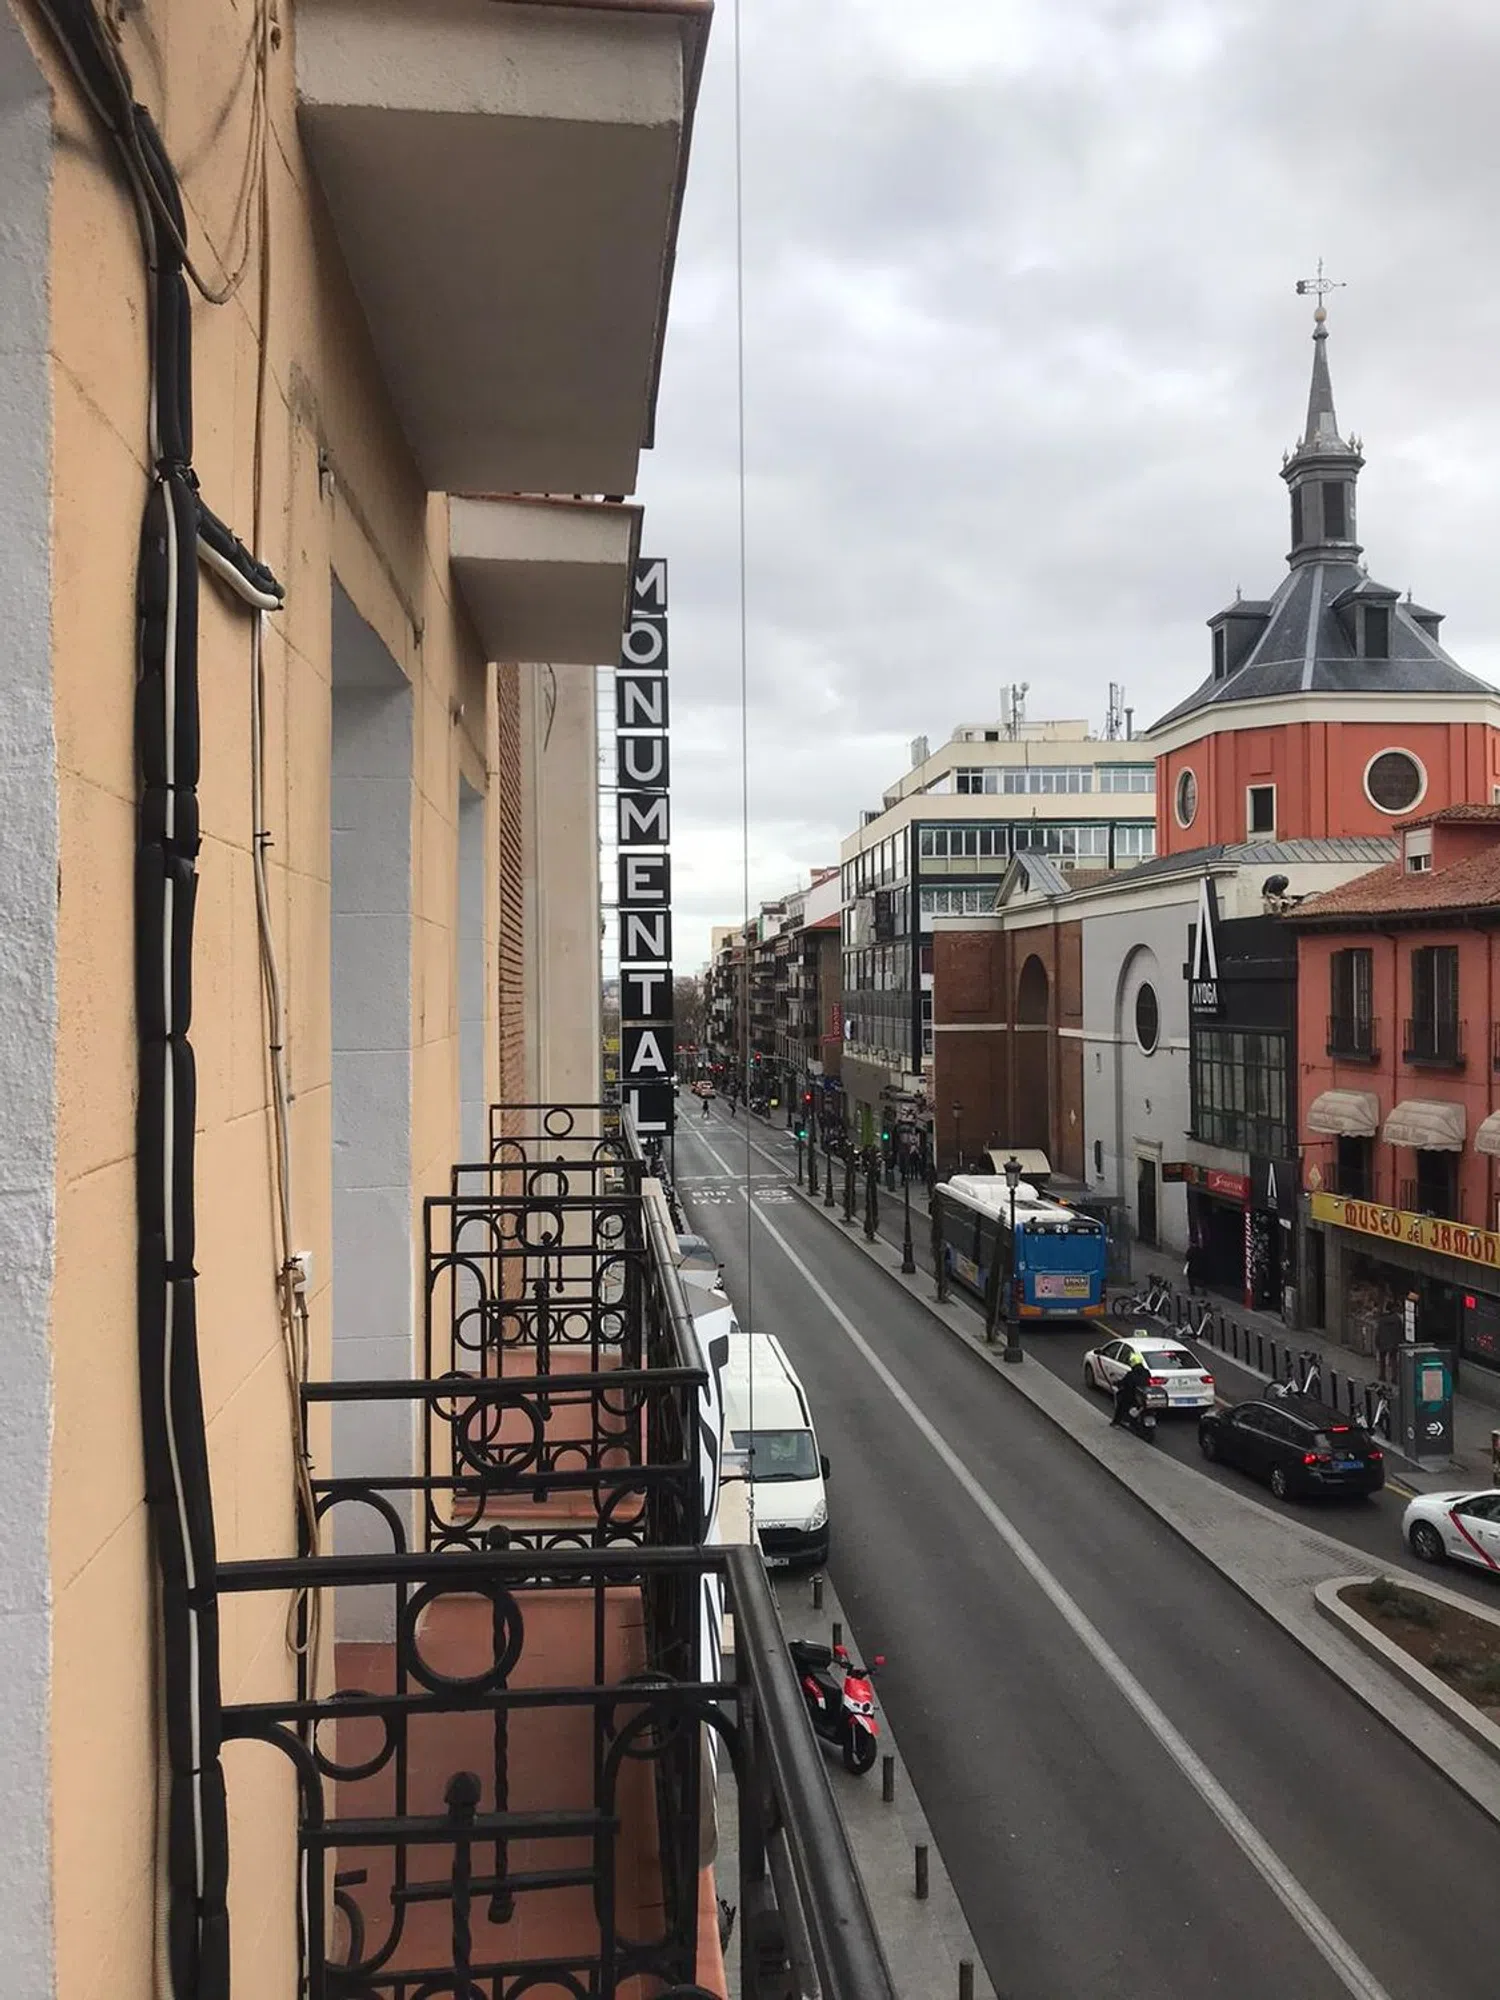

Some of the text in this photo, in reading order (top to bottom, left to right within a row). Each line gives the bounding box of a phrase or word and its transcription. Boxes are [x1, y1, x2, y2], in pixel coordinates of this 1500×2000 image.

[621, 561, 667, 1131] MONUMENTAL
[1054, 1223, 1070, 1234] 26
[1344, 1202, 1402, 1238] MUSEO
[1407, 1224, 1424, 1244] del
